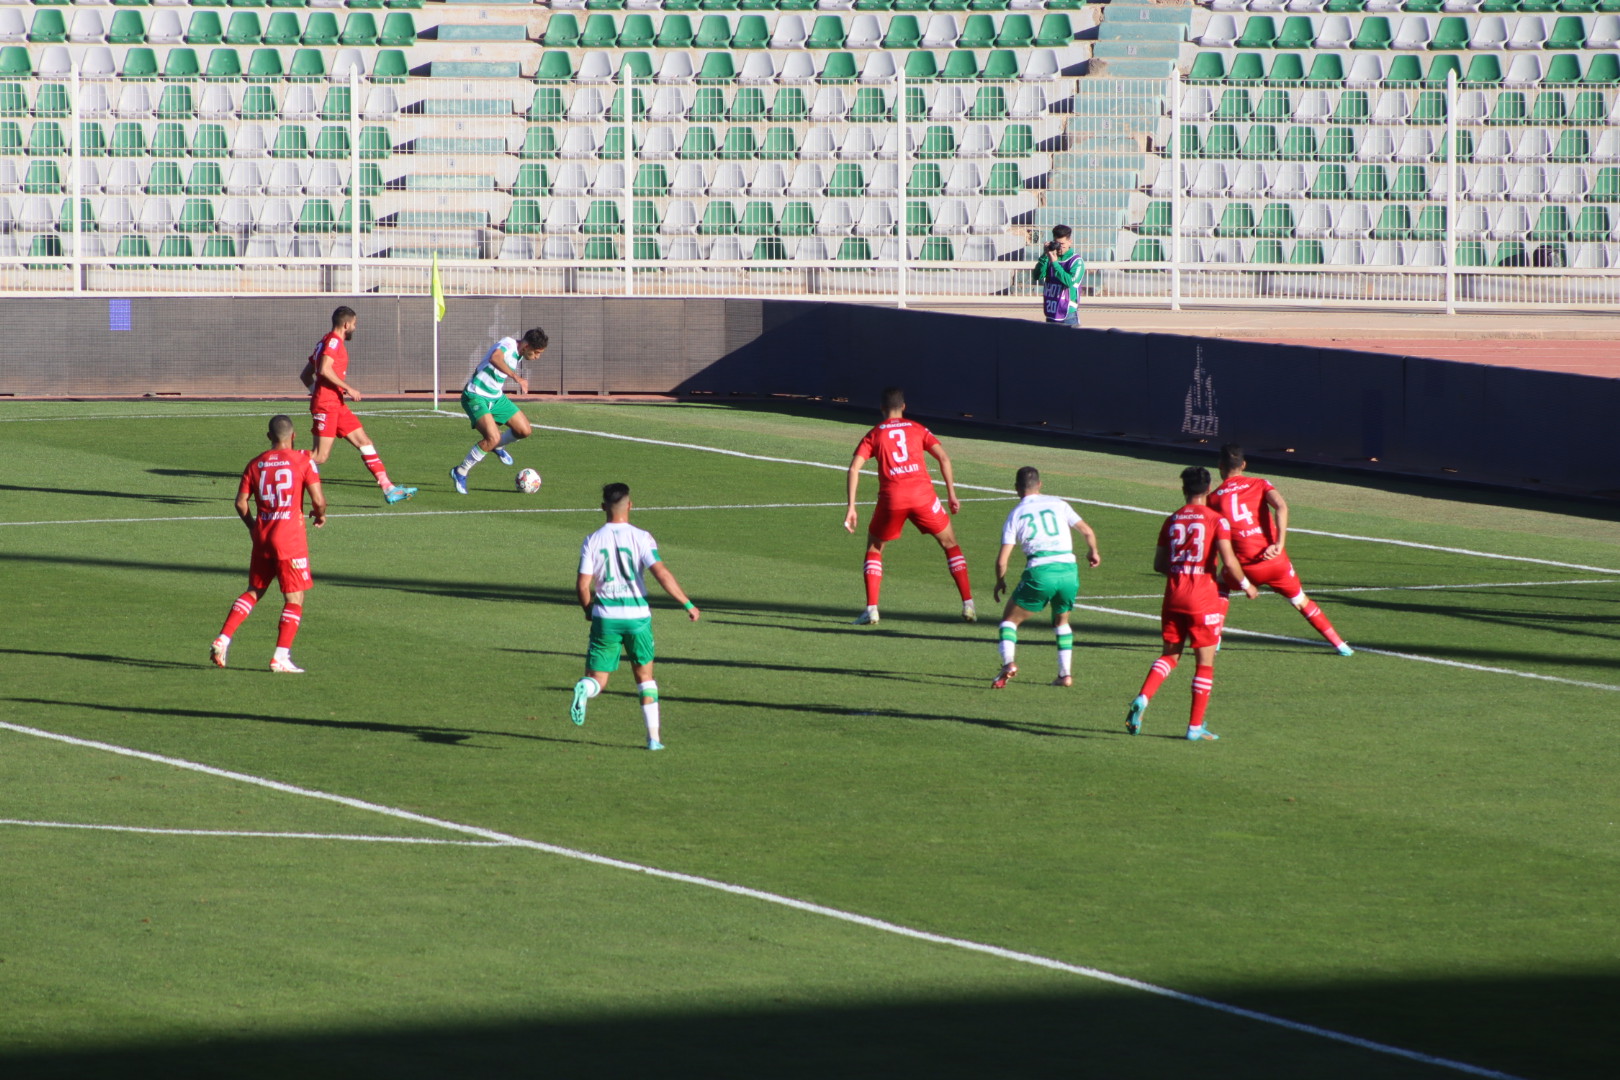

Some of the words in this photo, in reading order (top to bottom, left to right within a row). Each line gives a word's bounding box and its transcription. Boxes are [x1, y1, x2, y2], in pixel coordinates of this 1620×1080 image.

[1046, 300, 1058, 314] 20
[889, 429, 909, 462] 3
[259, 468, 292, 507] 42
[1019, 509, 1060, 541] 30
[1231, 493, 1254, 525] 4
[1169, 522, 1206, 562] 23
[599, 547, 635, 582] 10
